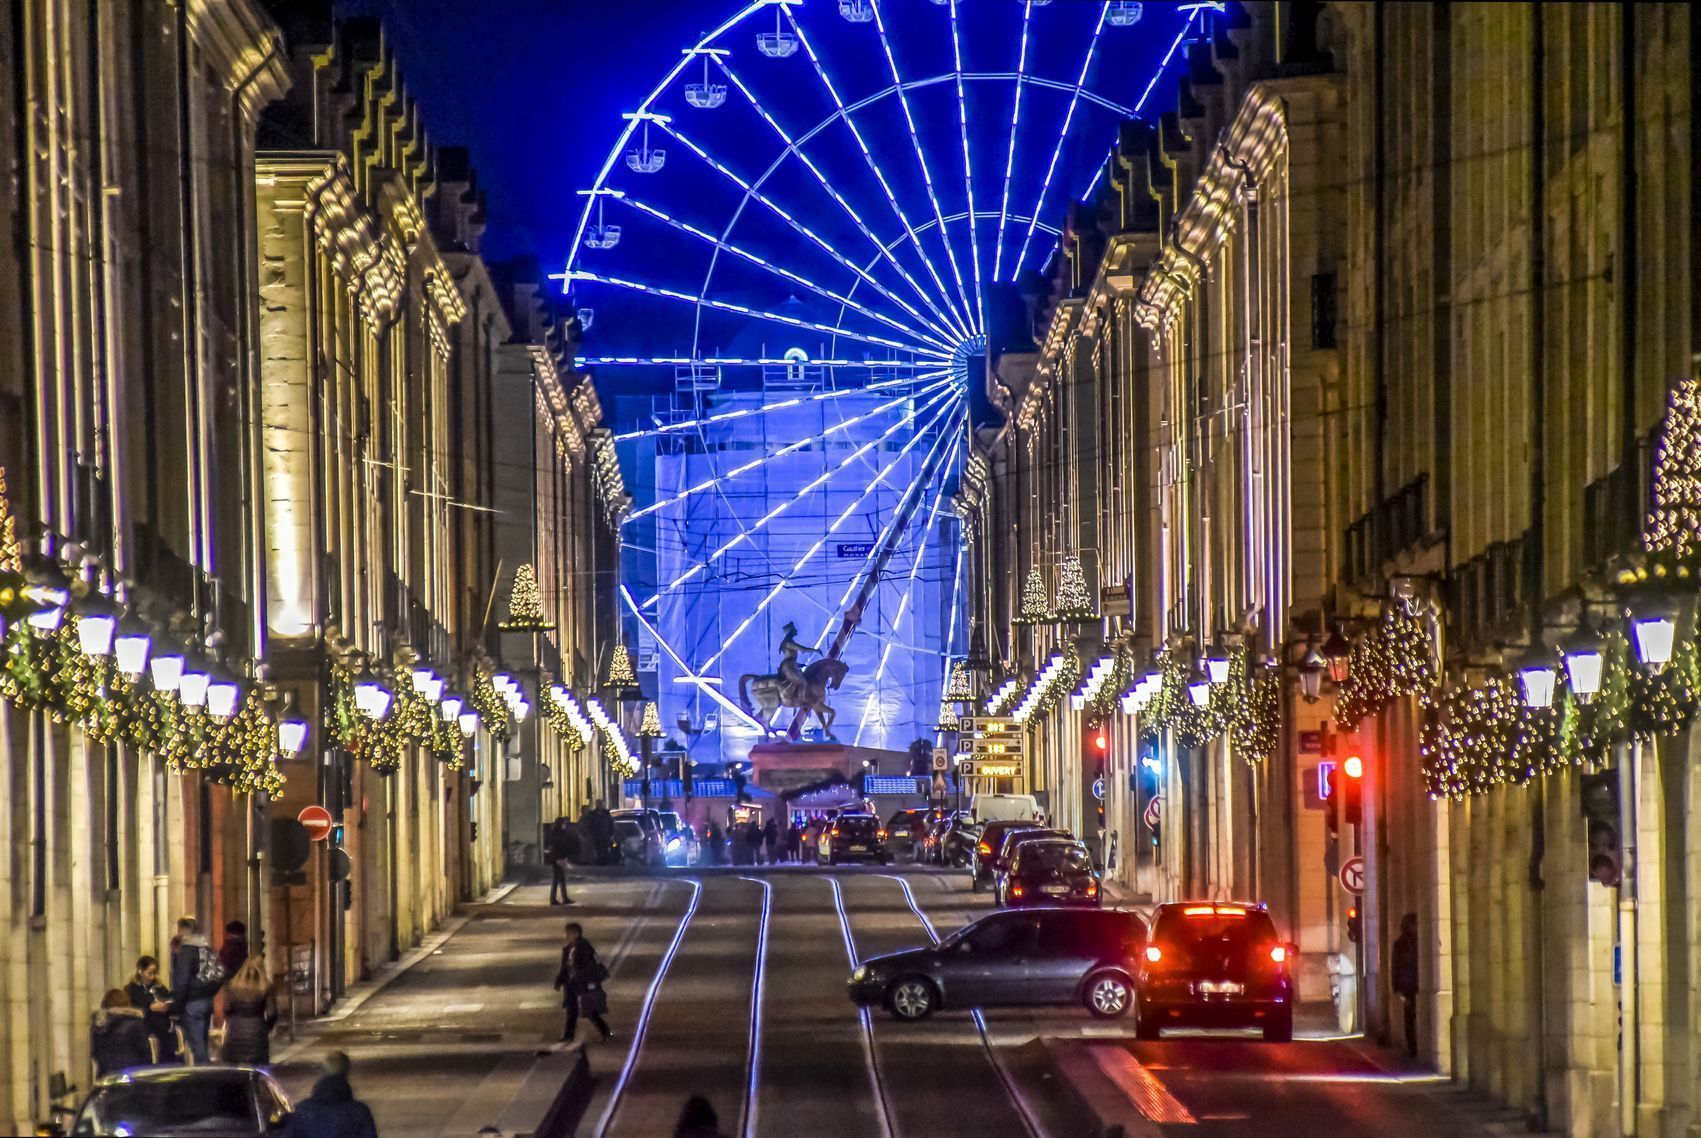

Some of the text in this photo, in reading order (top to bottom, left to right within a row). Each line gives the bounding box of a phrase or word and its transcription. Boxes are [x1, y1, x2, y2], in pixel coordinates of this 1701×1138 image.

[963, 720, 971, 731] P
[963, 741, 971, 752] P
[963, 763, 971, 774] P
[981, 766, 1016, 775] OUVERT
